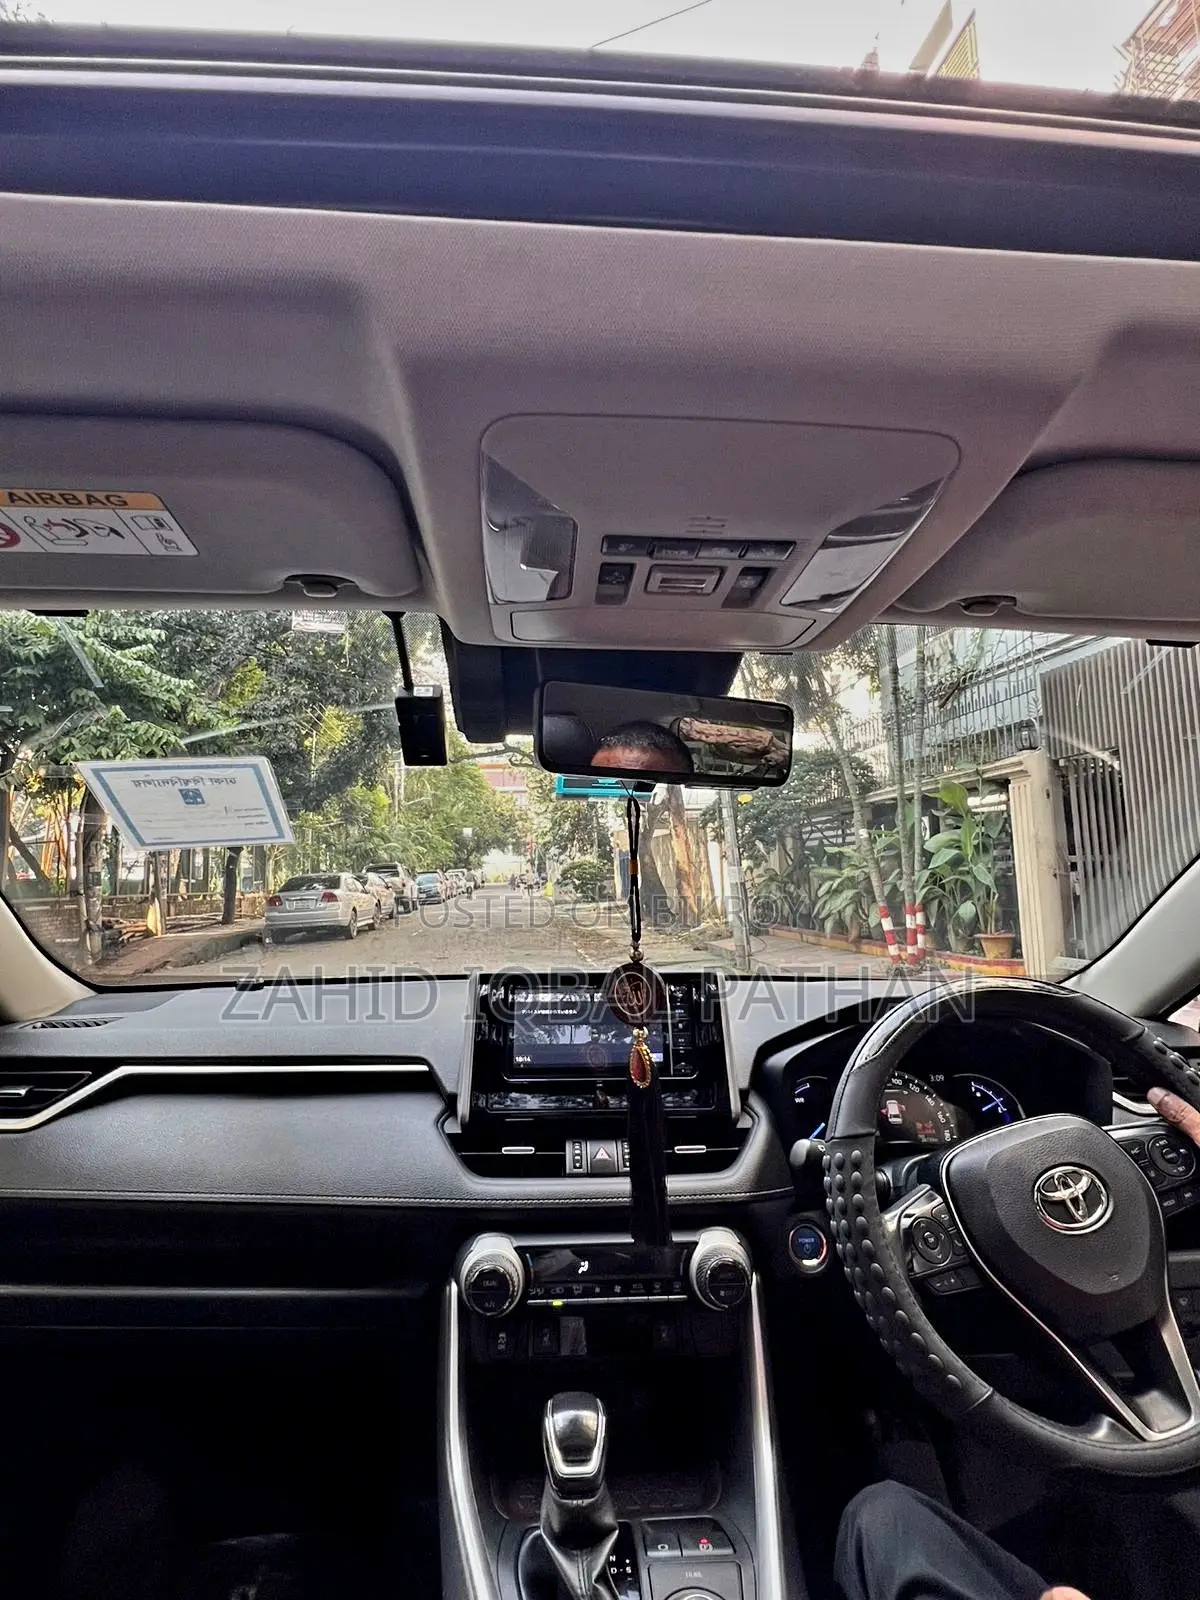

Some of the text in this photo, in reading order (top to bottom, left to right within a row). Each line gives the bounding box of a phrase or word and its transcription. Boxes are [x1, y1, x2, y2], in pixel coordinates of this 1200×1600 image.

[7, 491, 129, 507] AIRBAG
[891, 1077, 903, 1086] 100
[909, 1082, 920, 1093] 120
[937, 1110, 947, 1124] 160
[609, 1554, 616, 1562] N
